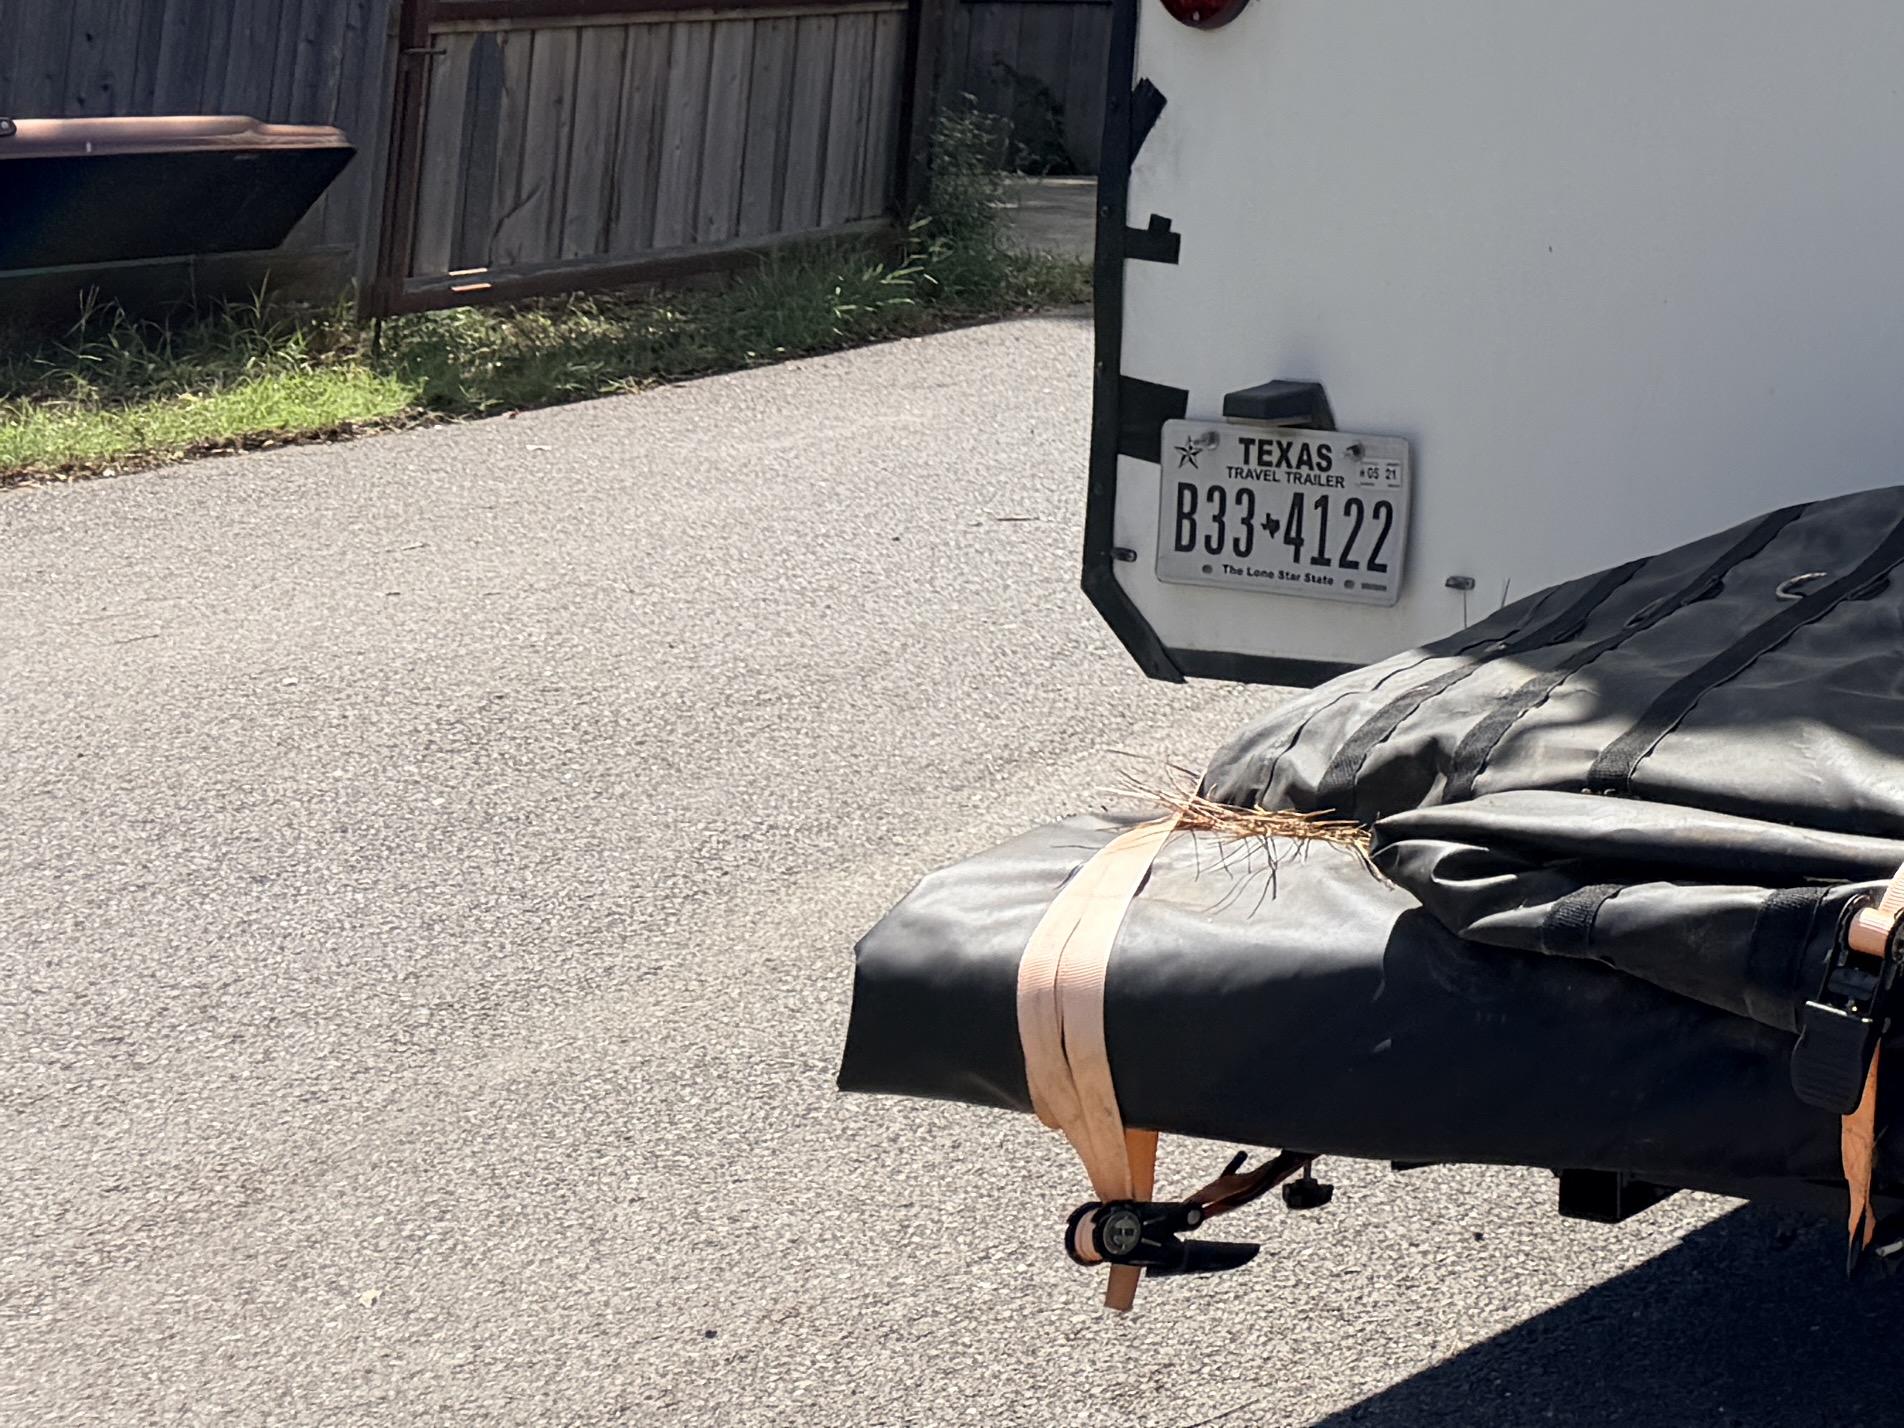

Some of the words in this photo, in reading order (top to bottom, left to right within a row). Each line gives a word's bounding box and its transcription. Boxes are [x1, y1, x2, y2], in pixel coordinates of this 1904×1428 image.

[1238, 437, 1333, 473] TEXAS
[1226, 466, 1281, 482] TRAVEL
[1285, 471, 1345, 489] TRAILER
[1222, 564, 1243, 576] The
[1246, 567, 1274, 580] Lone
[1278, 570, 1301, 582] Star
[1304, 572, 1334, 586] State
